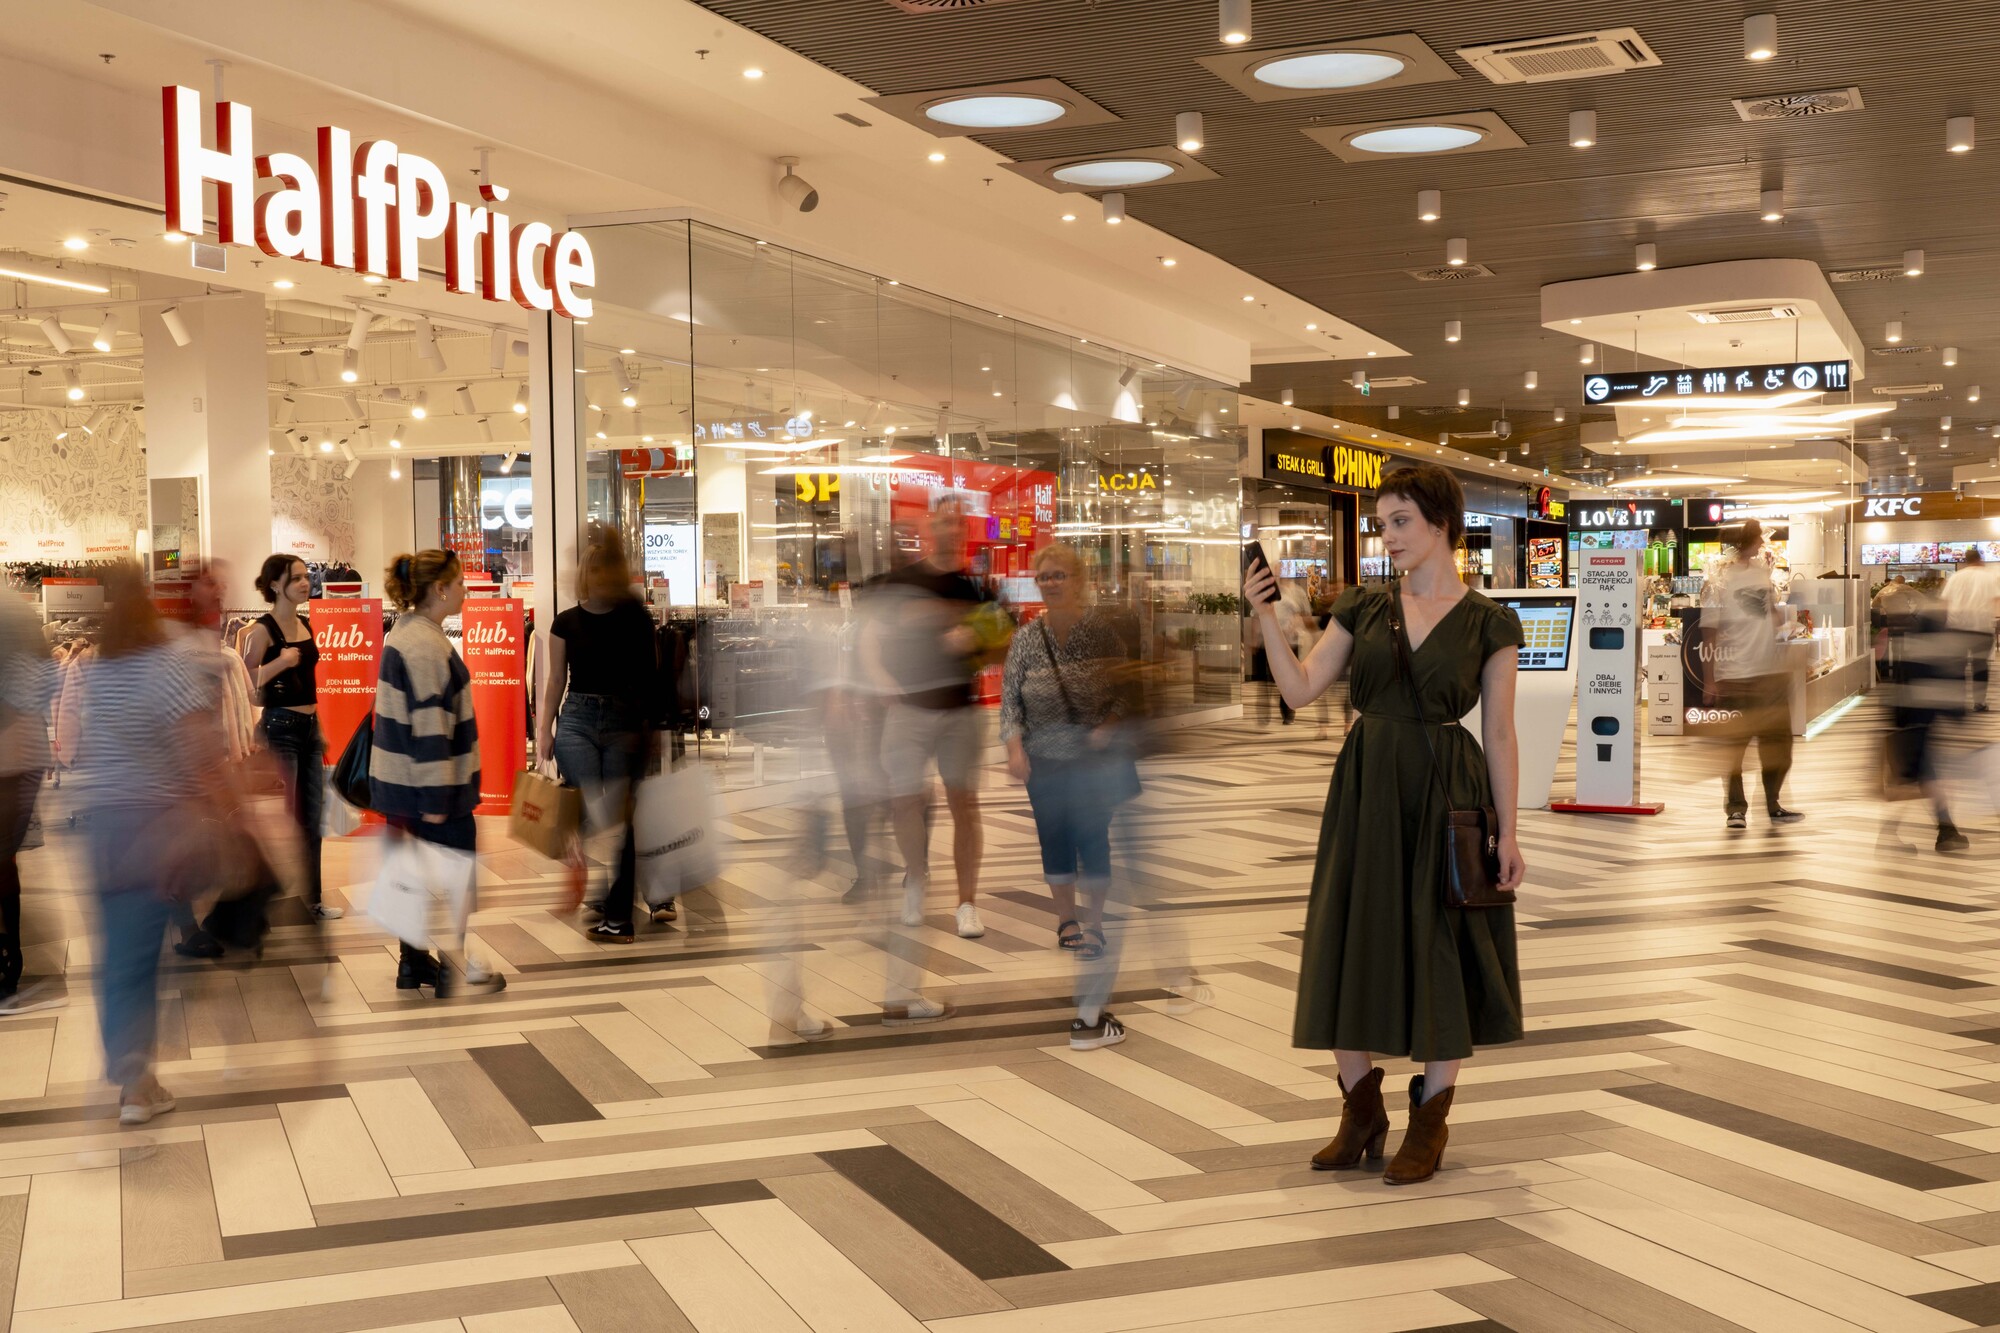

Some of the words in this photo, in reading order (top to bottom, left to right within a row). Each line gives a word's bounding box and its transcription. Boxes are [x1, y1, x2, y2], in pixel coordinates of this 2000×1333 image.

[162, 84, 595, 319] HalfPrice
[1277, 453, 1300, 473] STEAK
[1300, 458, 1306, 474] &
[1306, 459, 1326, 477] GRILL
[1333, 446, 1382, 489] SPHINX
[1034, 484, 1053, 505] Half
[1864, 497, 1922, 517] KFC
[1035, 505, 1053, 522] Price
[1579, 510, 1629, 526] LOVE
[1635, 510, 1655, 526] IT
[291, 541, 315, 549] HalfPrice
[646, 533, 675, 547] 30%
[1586, 570, 1615, 578] STACJA
[1599, 584, 1615, 592] RĄK
[66, 591, 83, 600] bluzy
[337, 653, 374, 661] HalfPrice
[467, 647, 481, 655] CCC
[485, 647, 516, 655] HalfPrice
[325, 679, 342, 687] JEDEN
[315, 686, 341, 695] ODWÓJNE
[343, 685, 377, 694] KORZYŚCI
